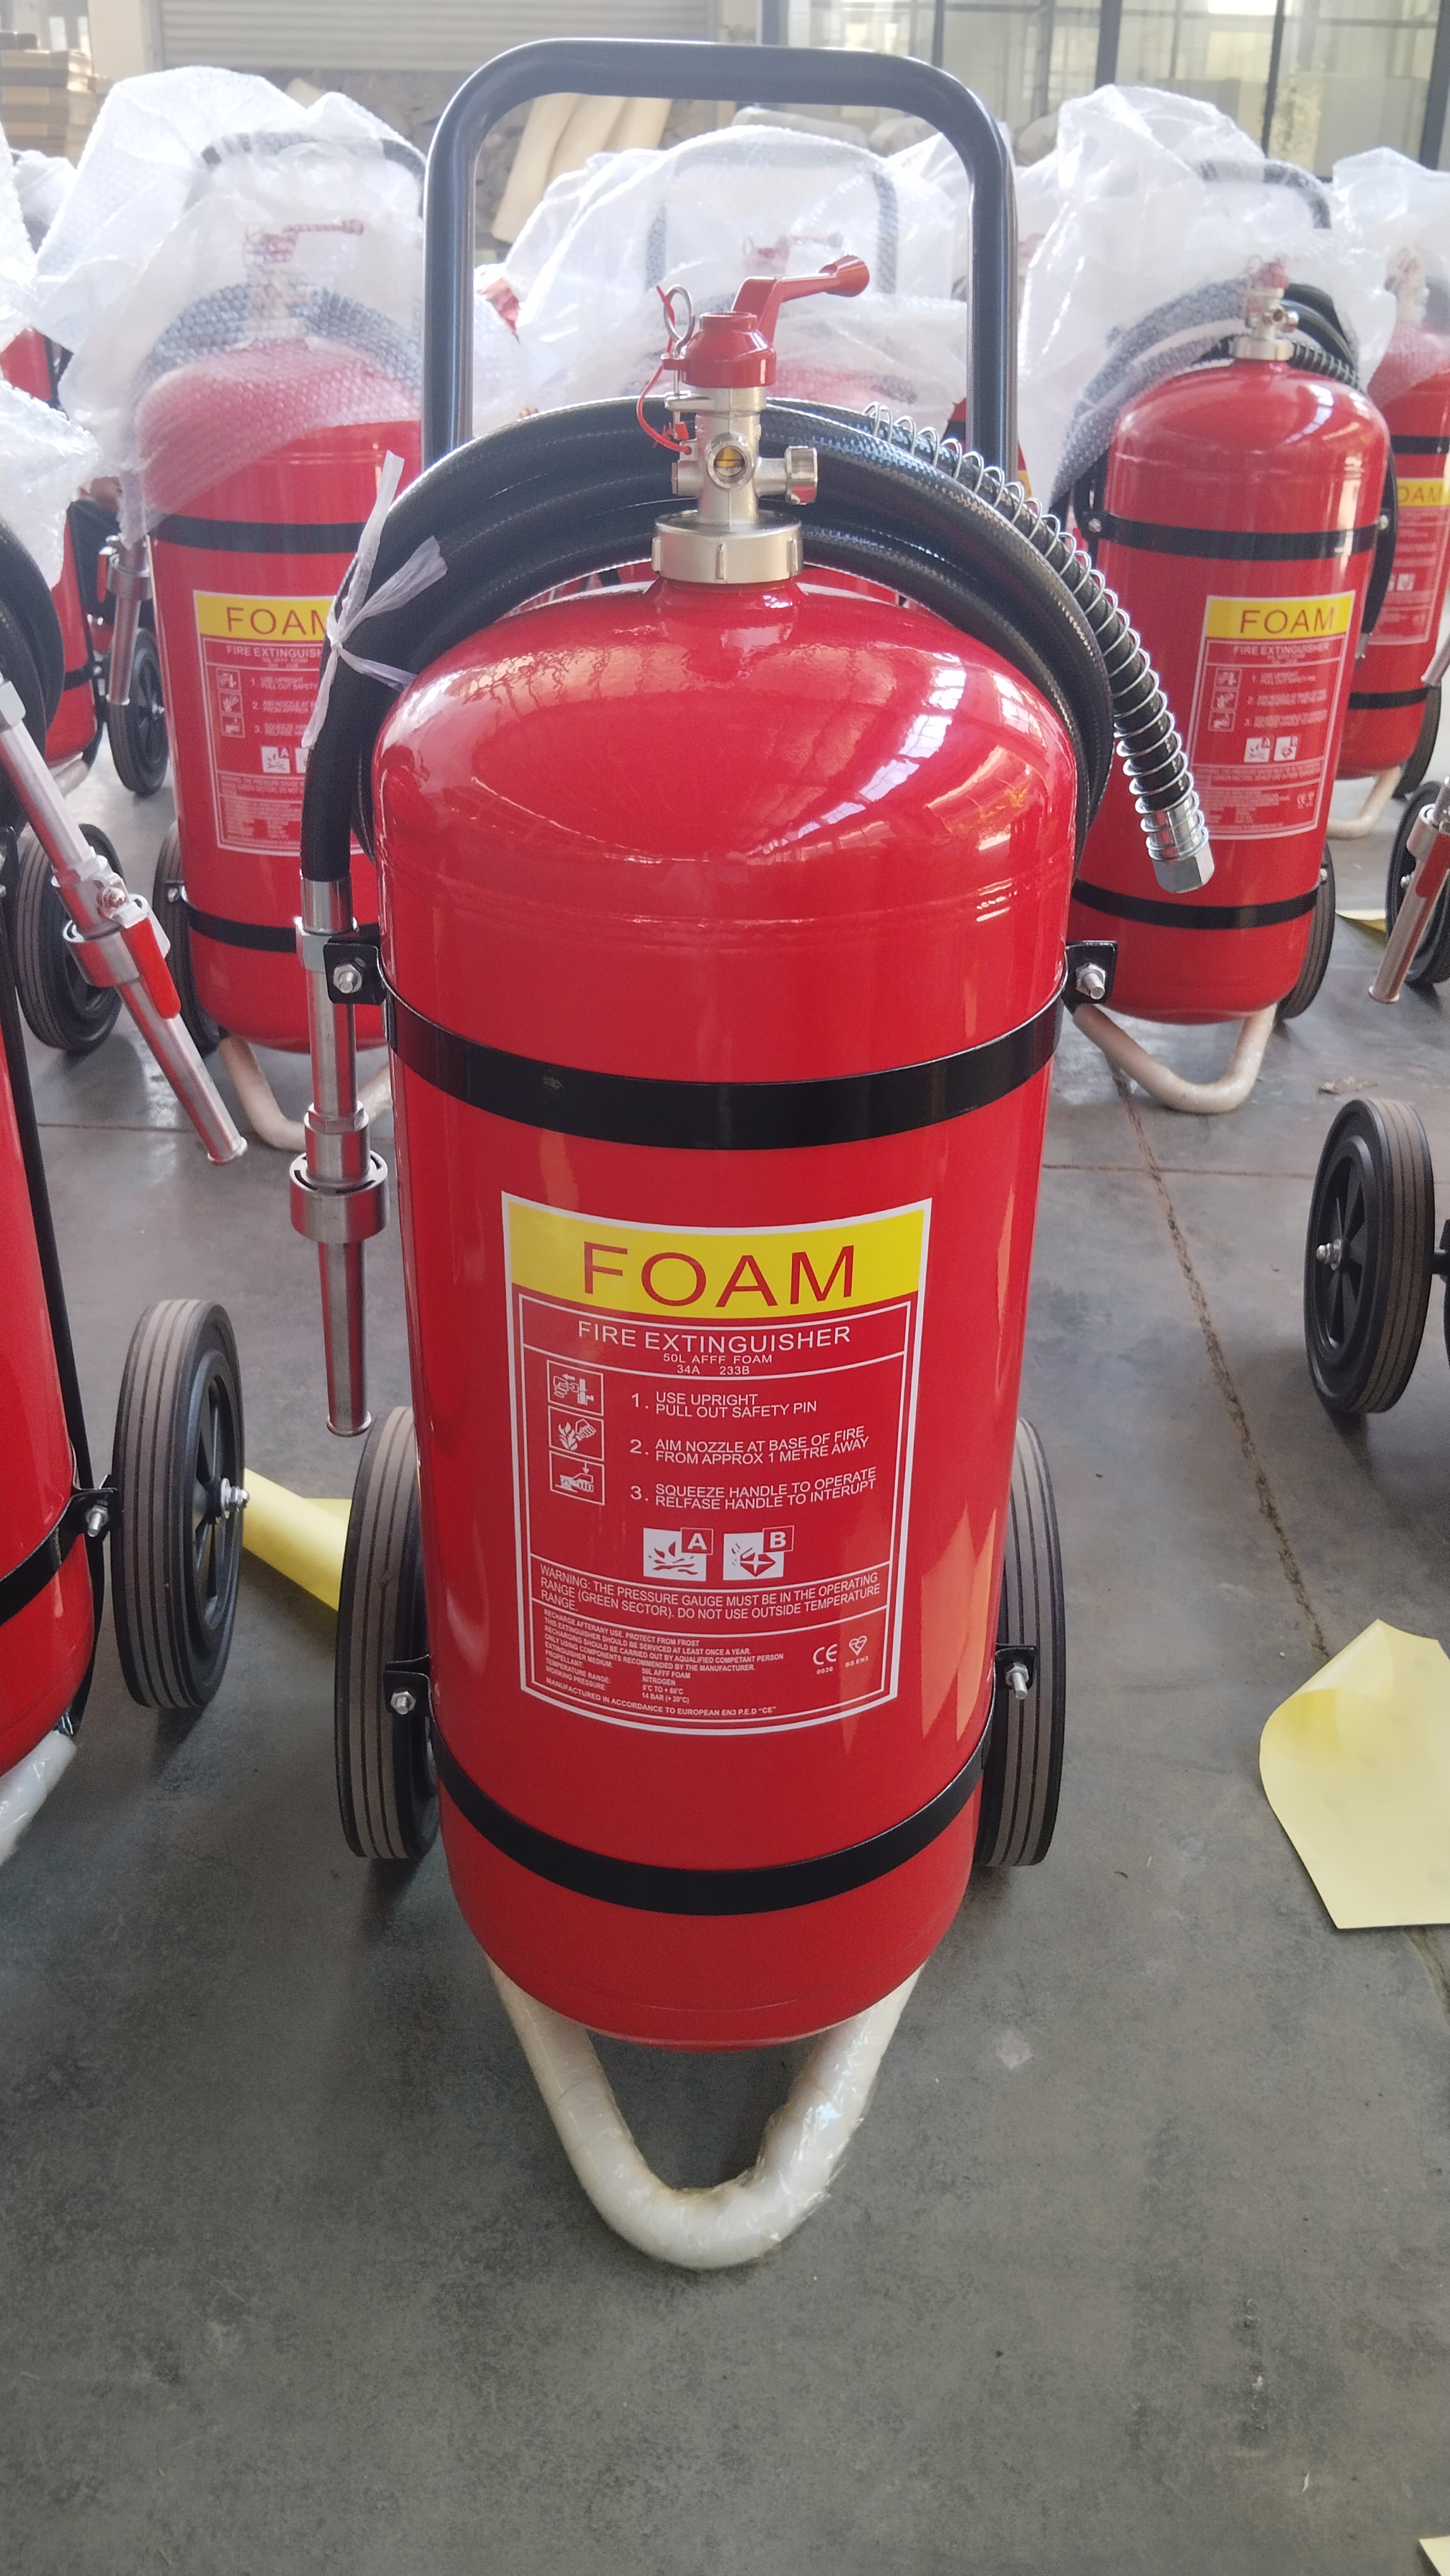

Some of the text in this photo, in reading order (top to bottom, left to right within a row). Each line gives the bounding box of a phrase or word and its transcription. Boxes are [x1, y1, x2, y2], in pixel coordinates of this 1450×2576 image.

[1240, 606, 1334, 634] FOAM
[225, 645, 250, 657] FIRE
[280, 748, 289, 758] A
[584, 1241, 854, 1308] FOAM
[579, 1321, 850, 1353] FIRE EXTINGUISHER
[663, 1353, 772, 1364] 50L AFFF FOAM
[677, 1364, 750, 1375] 34A 233B
[657, 1391, 686, 1404] USE
[692, 1394, 758, 1405] UPRIGHT
[657, 1401, 816, 1417] PULL OUT SAFETY PIN
[656, 1439, 681, 1451] AIM
[686, 1441, 743, 1452] NOZZLE
[747, 1441, 765, 1452] AT
[769, 1437, 806, 1451] BASE
[812, 1433, 829, 1446] OF
[835, 1426, 864, 1442] FIRE
[656, 1436, 868, 1464] FROM APPROX 1 METRE AWAY
[656, 1484, 724, 1498] SQUEEZE
[729, 1484, 787, 1498] HANDLE
[791, 1481, 810, 1493] TO
[815, 1467, 876, 1489] OPERATE
[656, 1478, 876, 1509] RELFASE HANDLE TO INTERUPT
[688, 1532, 707, 1549] A
[769, 1531, 786, 1548] B
[541, 1564, 877, 1606] WARNING: THE PRESSURE GAUGE MUST BE IN THE OPERATING
[541, 1577, 880, 1619] RANGE (GREEN SECTOR). DO NOT USE OUTSIDE TEMPERATURE
[542, 1589, 578, 1611] RANGE.
[544, 1609, 575, 1625] RECHARGE
[626, 1633, 656, 1642] PROTECT
[544, 1617, 557, 1626] THIS
[558, 1623, 601, 1640] EXTINGUISHER
[602, 1635, 628, 1646] SHOULD
[640, 1643, 671, 1653] SERVICED
[545, 1625, 582, 1643] RECHARGING
[584, 1638, 608, 1650] SHOULD
[620, 1648, 648, 1658] CARRIED
[545, 1633, 559, 1643] ONLY
[561, 1639, 578, 1650] USING
[580, 1646, 621, 1661] COMPONENTS
[623, 1657, 673, 1669] RECOMMENDED
[545, 1641, 586, 1661] EXTINGUISHER
[813, 1643, 837, 1665] CE
[546, 1649, 676, 1685] PROPELLANT: NITROGEN
[546, 1657, 586, 1677] TEMPERATURE
[588, 1673, 611, 1683] RANGE:
[546, 1666, 572, 1680] WORKING
[546, 1677, 601, 1700] MANUFACTURED
[611, 1698, 663, 1712] ACCORDANCE
